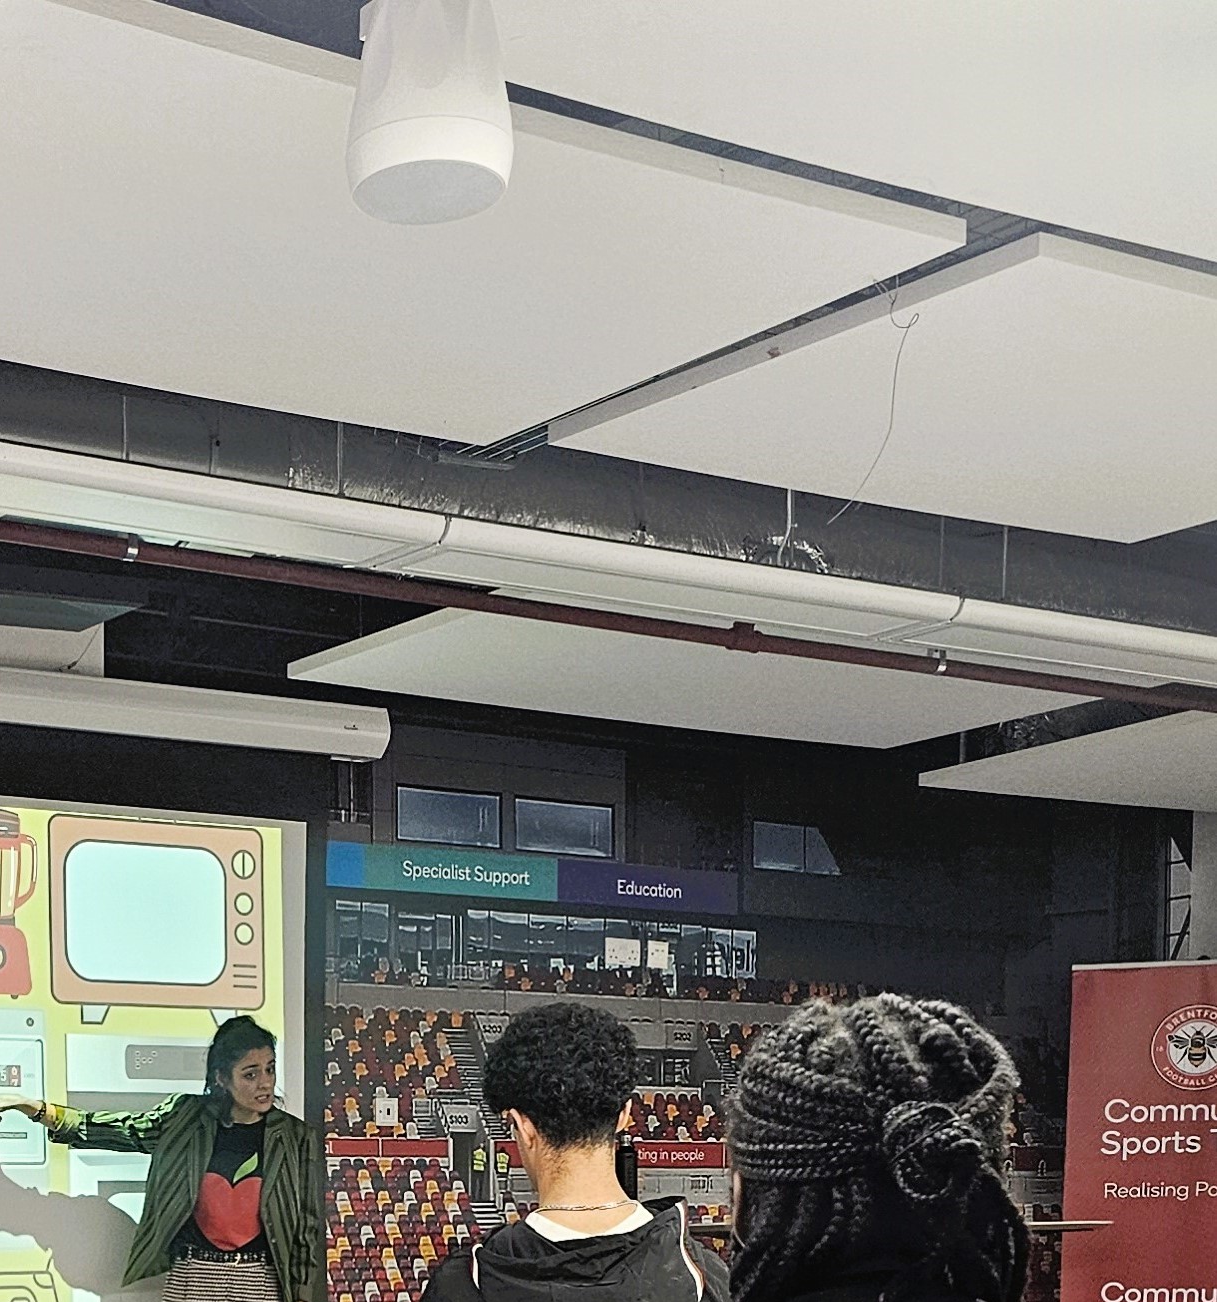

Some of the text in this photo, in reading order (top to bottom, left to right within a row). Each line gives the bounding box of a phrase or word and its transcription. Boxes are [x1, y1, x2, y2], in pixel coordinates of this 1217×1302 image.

[402, 860, 531, 887] Specialist Support
[617, 879, 682, 899] Education
[1163, 1066, 1206, 1087] FOOTBALL
[659, 1147, 668, 1160] in
[670, 1148, 705, 1163] people
[1100, 1129, 1202, 1161] Sports
[1104, 1181, 1189, 1201] Realising
